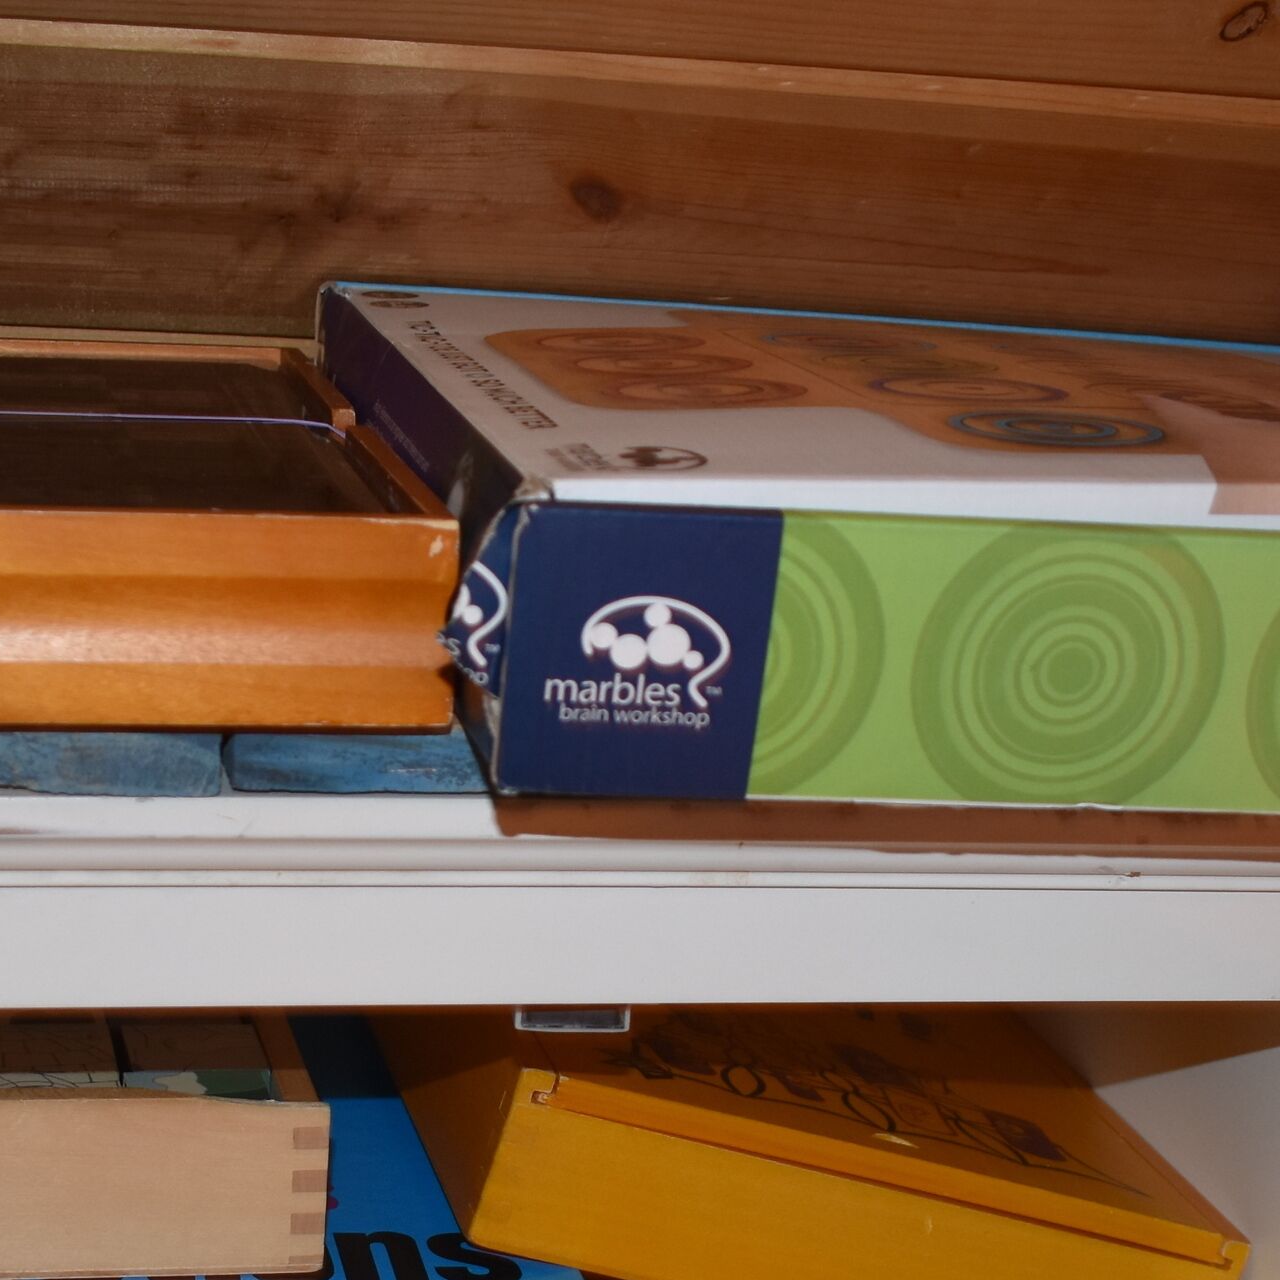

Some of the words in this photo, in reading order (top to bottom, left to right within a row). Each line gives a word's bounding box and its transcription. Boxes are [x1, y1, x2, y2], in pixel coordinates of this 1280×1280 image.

[543, 673, 681, 707] marbles
[558, 702, 610, 723] brain
[613, 706, 711, 730] workshop
